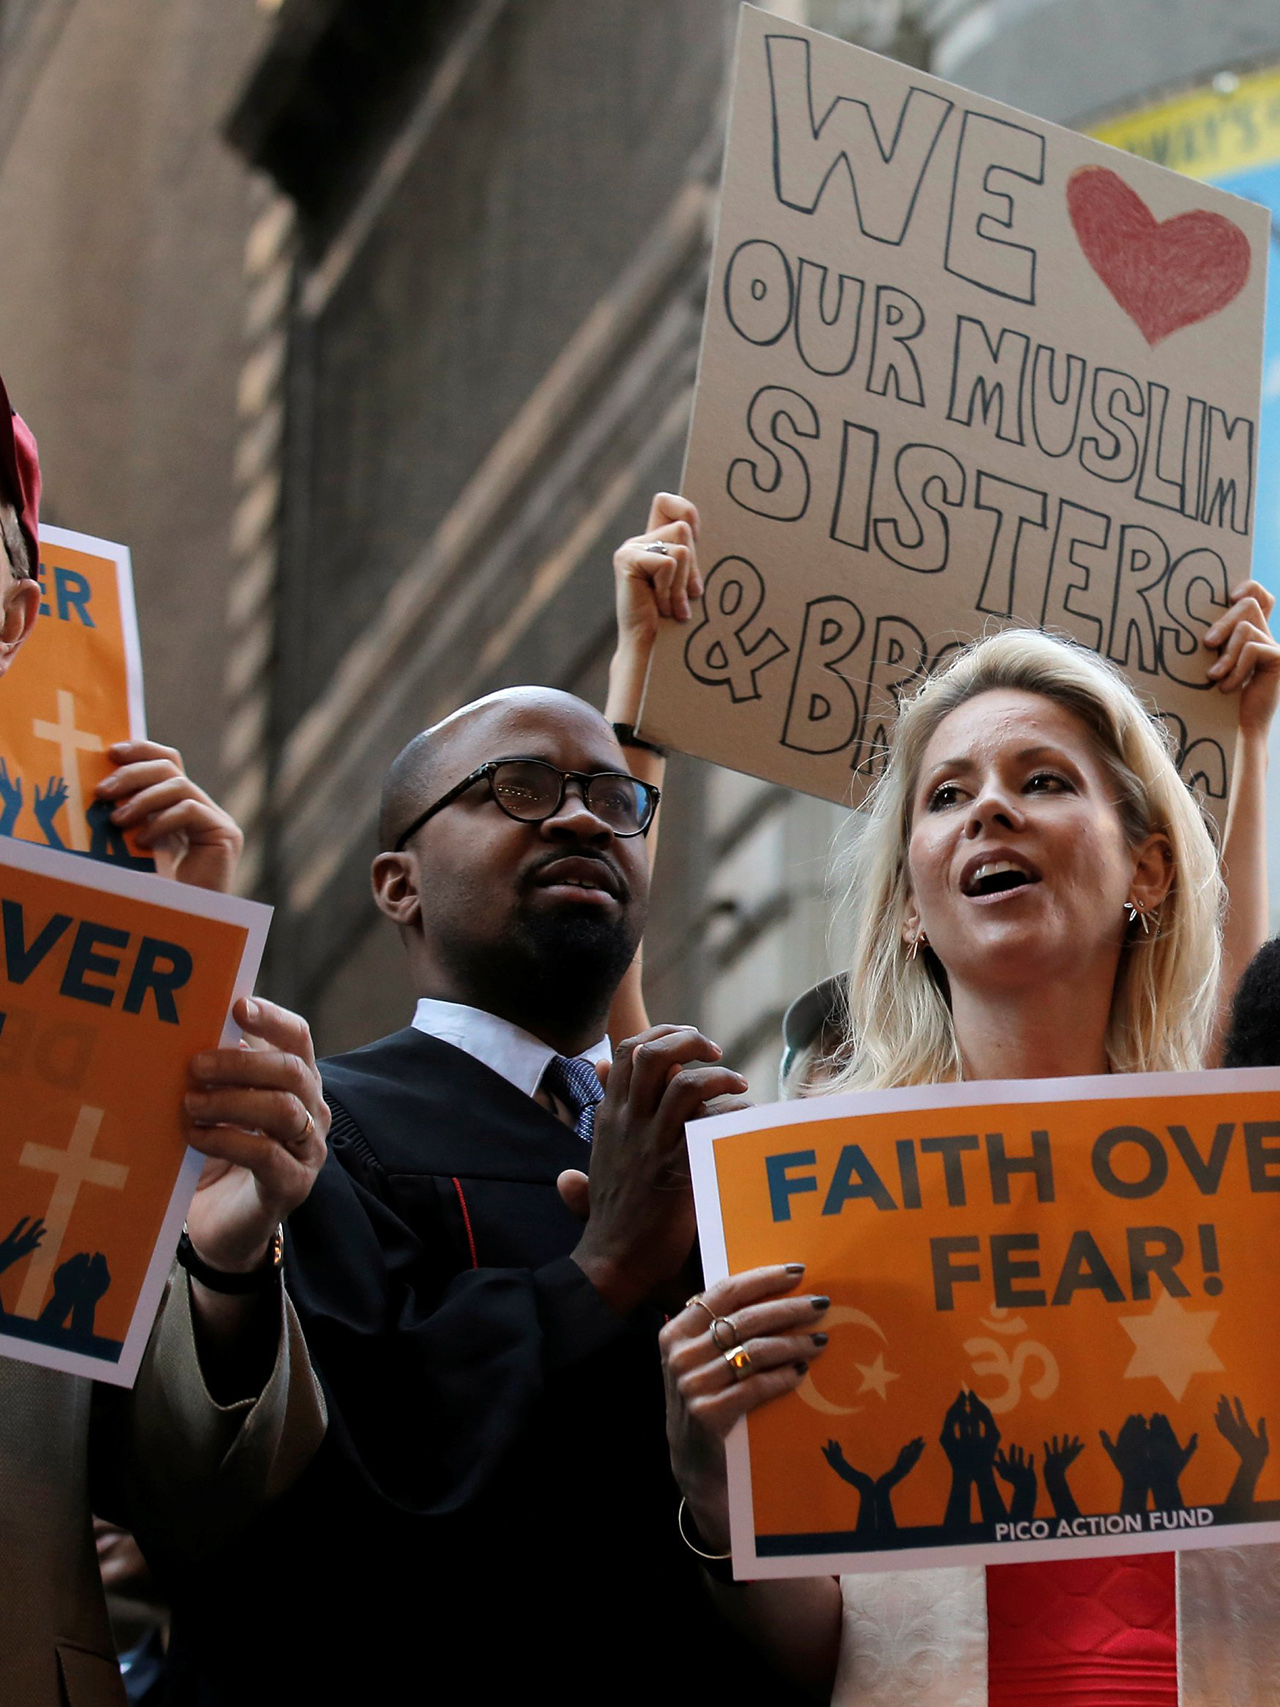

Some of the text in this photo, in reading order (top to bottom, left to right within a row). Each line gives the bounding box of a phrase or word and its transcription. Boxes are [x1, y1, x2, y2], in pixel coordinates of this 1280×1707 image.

[765, 34, 1046, 306] WE
[724, 239, 1255, 535] OUR MUSLIM
[726, 385, 1230, 690] SISTERS
[683, 555, 790, 702] &
[0, 900, 194, 1026] VER
[764, 1129, 1056, 1222] FAITH
[929, 1223, 1225, 1312] FEAR!
[994, 1507, 1215, 1542] PICO ACTION FUND
